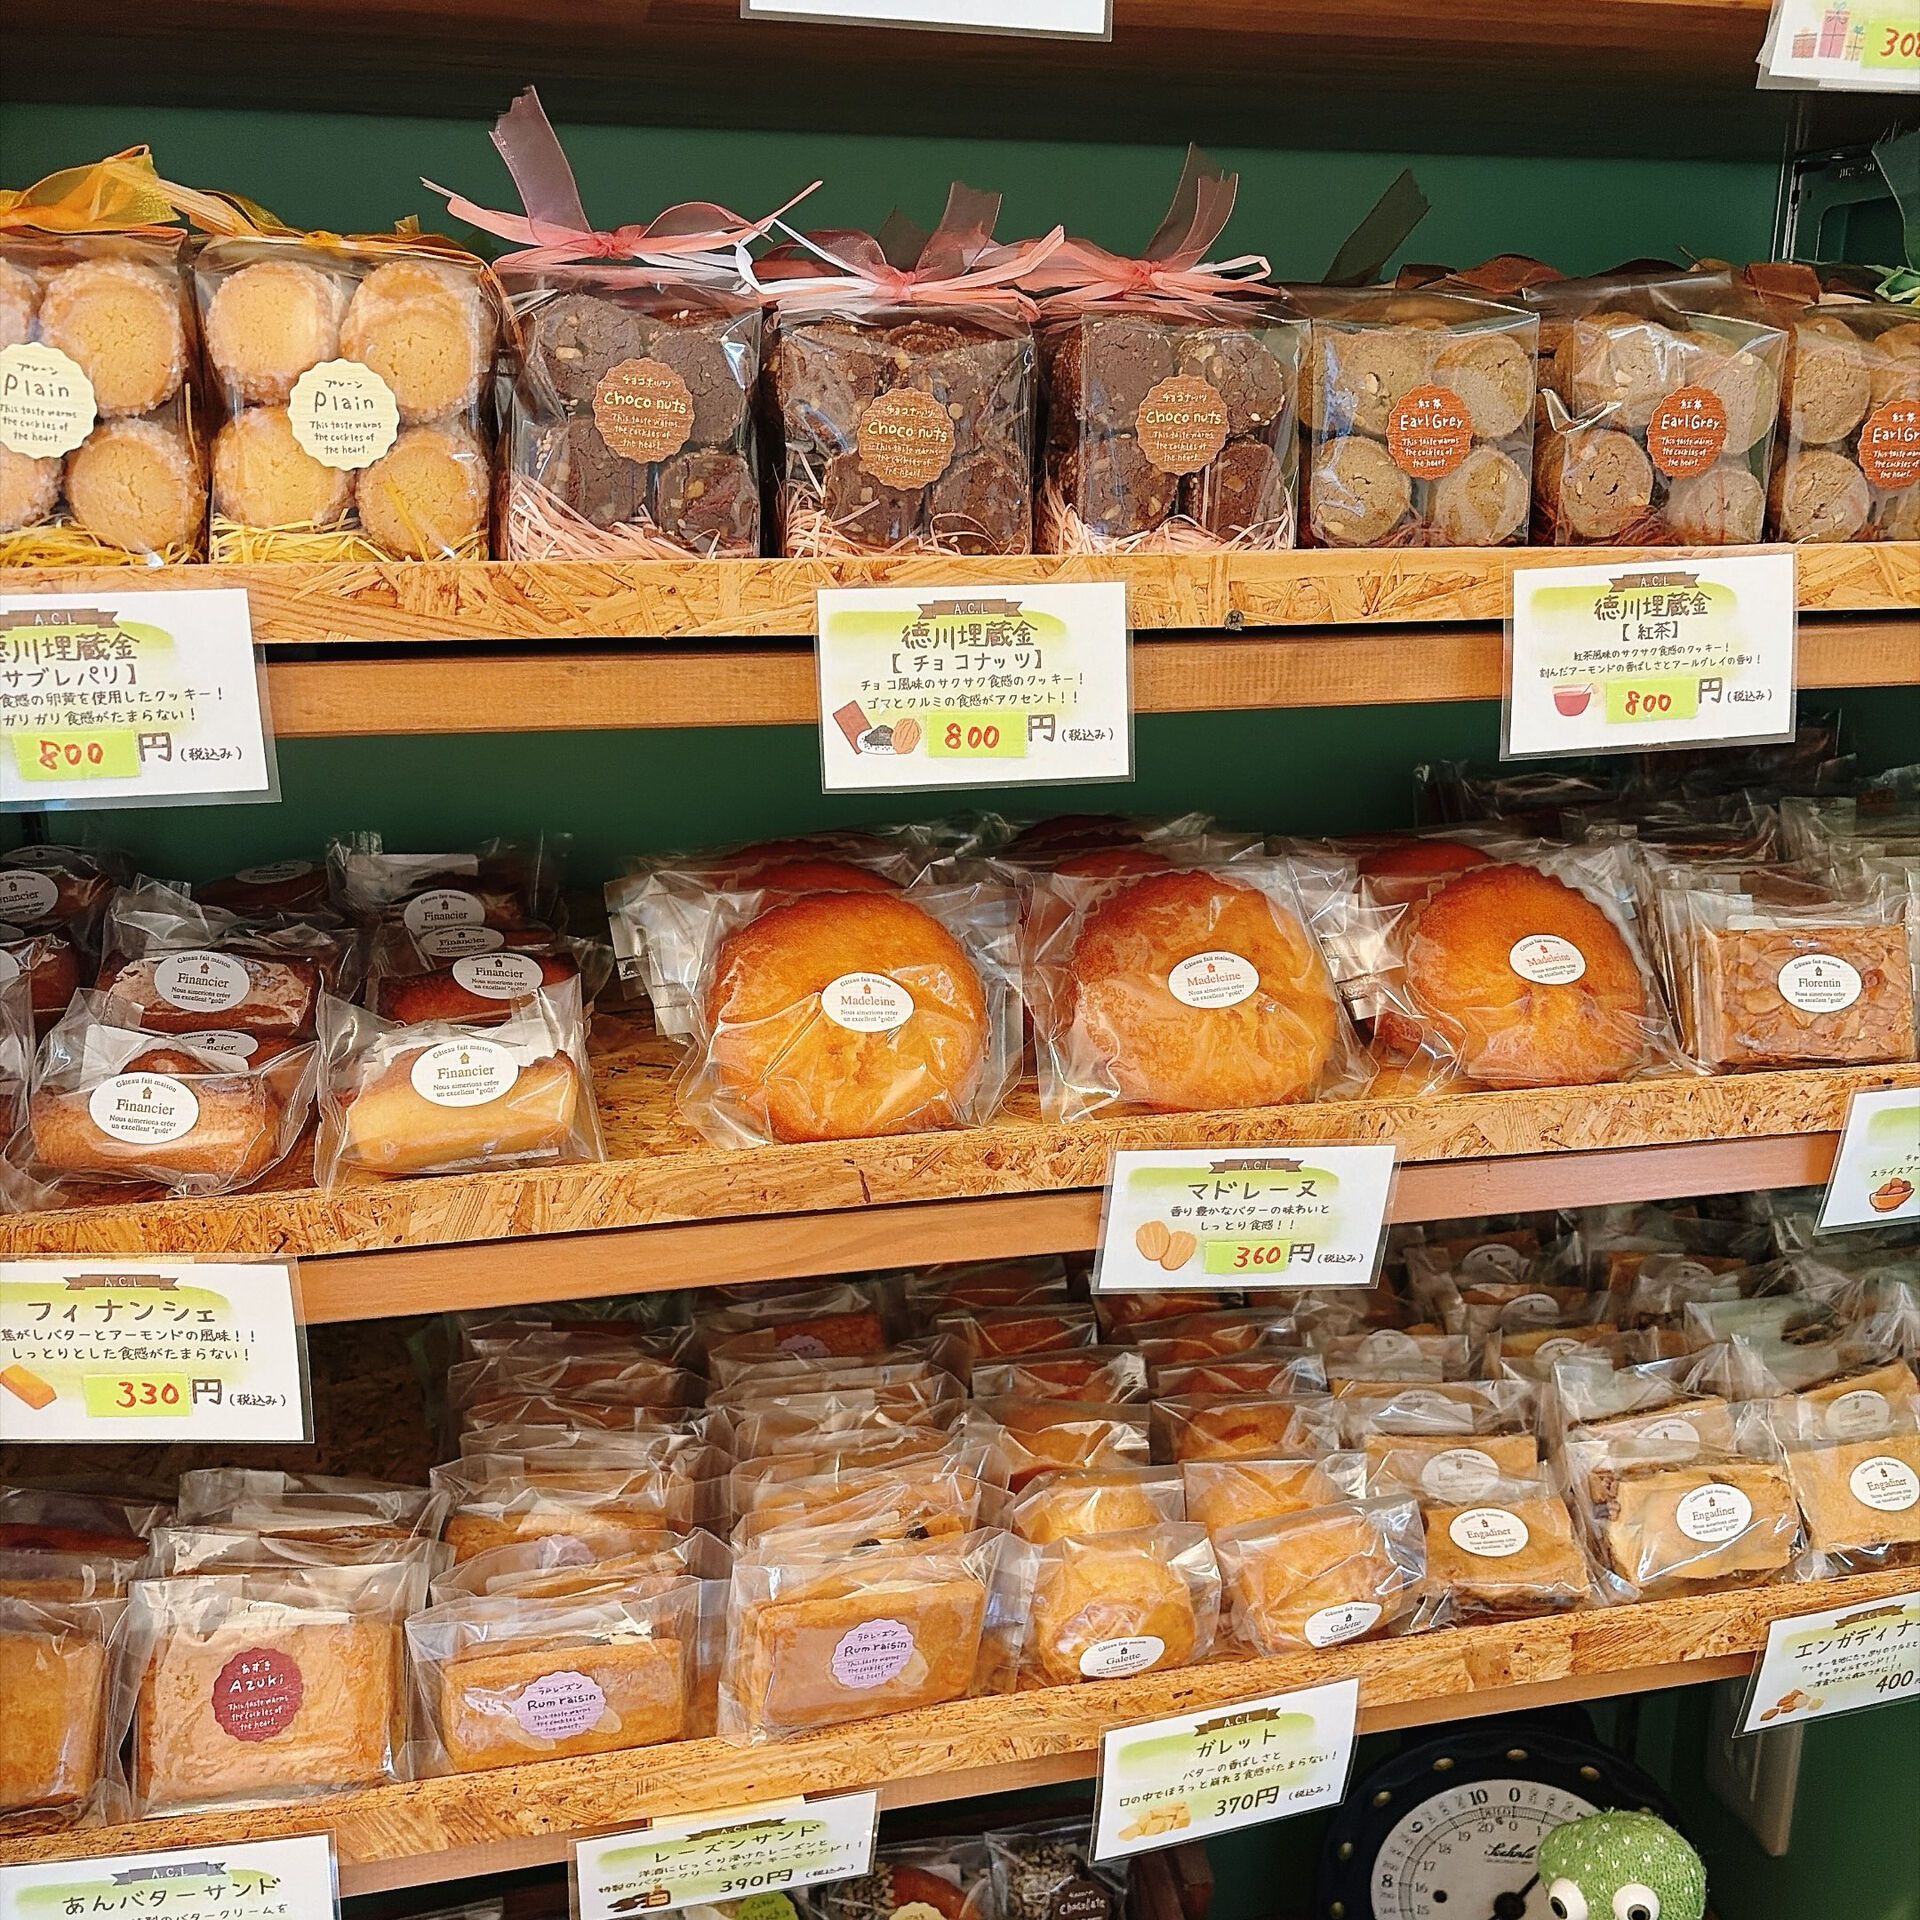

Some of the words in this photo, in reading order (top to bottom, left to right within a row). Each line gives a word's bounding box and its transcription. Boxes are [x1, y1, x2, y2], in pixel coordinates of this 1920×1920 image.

[4, 373, 69, 397] Plain
[314, 390, 374, 413] Plain
[603, 390, 652, 409] Choco
[656, 398, 687, 415] nuts
[21, 406, 45, 417] taste
[48, 410, 77, 418] warms
[1146, 410, 1190, 425] Choco
[1194, 410, 1222, 425] nuts
[20, 420, 56, 431] cockles
[59, 422, 68, 431] of
[309, 420, 329, 430] This
[331, 421, 353, 430] taste
[355, 421, 382, 429] warms
[1400, 414, 1430, 431] Earl
[1432, 413, 1464, 429] Grey
[1661, 413, 1688, 431] Earl
[1691, 414, 1720, 430] Grey
[14, 431, 28, 440] the
[314, 432, 328, 441] the
[331, 433, 363, 442] cockles
[366, 433, 374, 442] of
[867, 420, 914, 438] Choco
[918, 426, 948, 442] nuts
[1872, 426, 1902, 443] Earl
[324, 445, 339, 455] the
[342, 445, 369, 455] heart.
[1640, 575, 1670, 588] A.C.L
[953, 602, 989, 615] A.C.L
[1594, 591, 1712, 621] 徳川埋蔵金
[34, 612, 77, 626] A.C.L
[901, 620, 1038, 650] 徳川埋蔵金
[1621, 620, 1679, 642] 【紅茶】
[1625, 690, 1672, 716] 800
[1698, 677, 1723, 705] 円
[944, 722, 1000, 749] 800
[1027, 713, 1056, 743] 円
[39, 739, 104, 770] 800
[138, 731, 173, 763] 円
[424, 910, 469, 921] Financier
[1526, 952, 1571, 967] Madeleine
[177, 972, 230, 989] Financier
[474, 967, 524, 979] Financier
[1186, 972, 1241, 987] Madeleine
[1798, 977, 1841, 988] Florentin
[840, 995, 896, 1007] Madeleine
[436, 1064, 495, 1080] Financier
[116, 1098, 175, 1115] Financier
[109, 1114, 126, 1123] Nous
[1241, 1160, 1272, 1170] A.C.L
[1187, 1179, 1318, 1200] マドレーヌ
[1233, 1246, 1281, 1268] 360
[1288, 1243, 1315, 1263] 円
[104, 1276, 142, 1288] A.C.L
[27, 1299, 216, 1323] フィナンシェ
[116, 1381, 180, 1408] 330
[192, 1378, 223, 1405] 円
[1866, 1478, 1908, 1491] Engadiner
[1691, 1507, 1737, 1521] Engadiner
[1465, 1528, 1512, 1539] Engadiner
[1795, 1619, 1920, 1659] エンガディナ
[844, 1645, 870, 1657] Rum
[873, 1641, 907, 1651] raisin
[1106, 1653, 1141, 1665] Galette
[229, 1674, 284, 1693] Azuki
[228, 1703, 244, 1711] This
[245, 1699, 264, 1709] taste
[266, 1695, 288, 1704] warms
[527, 1699, 556, 1711] Rum
[559, 1693, 596, 1705] raisin
[231, 1713, 243, 1721] the
[245, 1709, 273, 1720] cockles
[275, 1705, 282, 1714] of
[1196, 1728, 1277, 1758] ガレット
[1214, 1786, 1280, 1817] 370円
[1468, 1788, 1489, 1806] 10
[1508, 1787, 1520, 1802] 0
[1410, 1821, 1424, 1833] 9
[1478, 1822, 1494, 1833] 20
[1508, 1821, 1518, 1831] 0
[655, 1824, 821, 1863] レーズンサンド
[1458, 1831, 1471, 1841] 19
[1423, 1860, 1436, 1872] 17
[720, 1868, 793, 1893] 390円
[1381, 1873, 1394, 1888] 8
[63, 1877, 282, 1915] あんバターサンド
